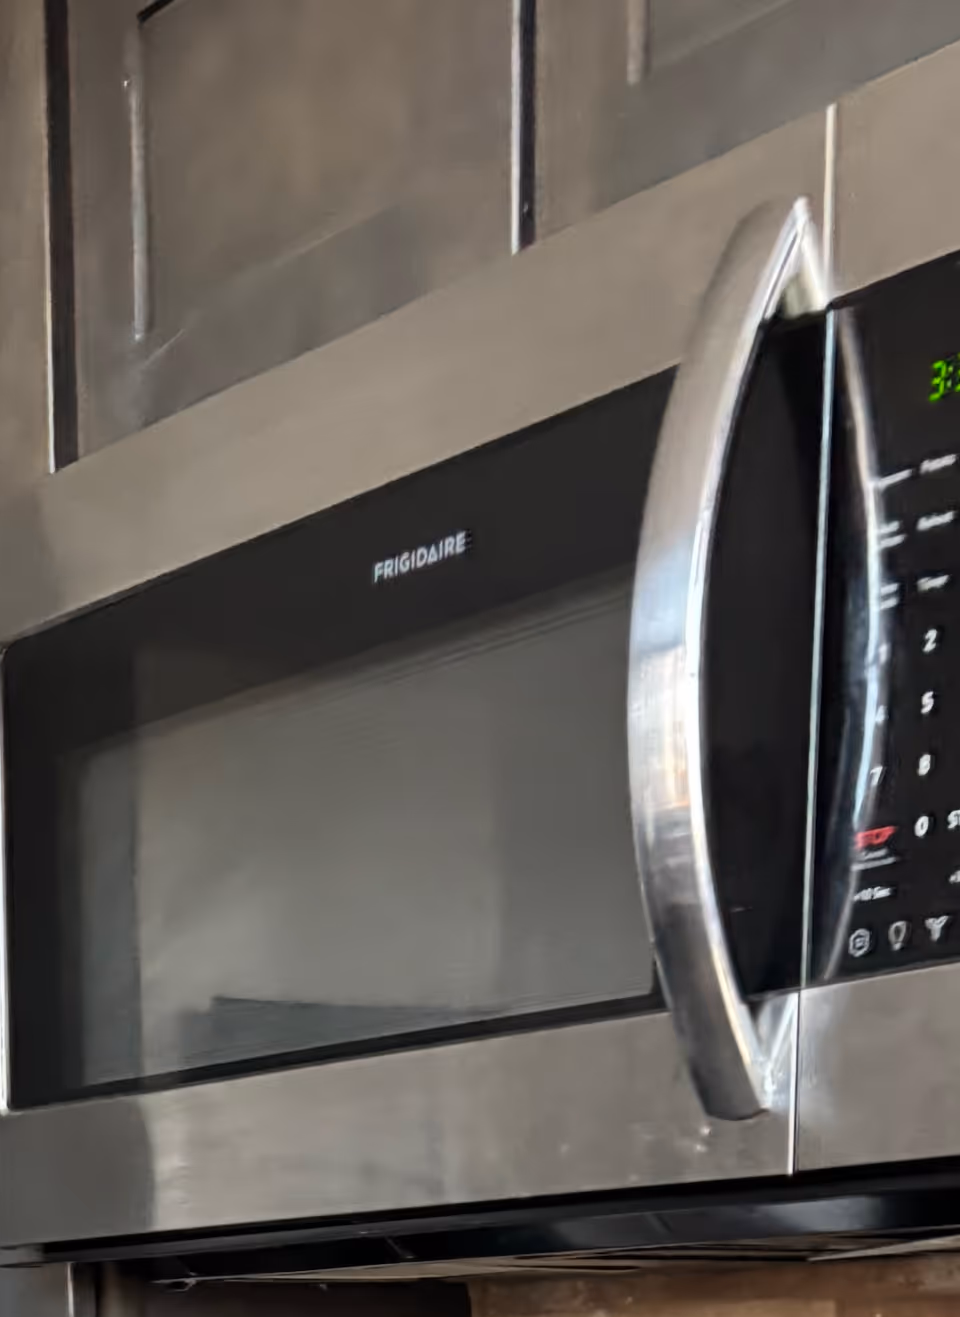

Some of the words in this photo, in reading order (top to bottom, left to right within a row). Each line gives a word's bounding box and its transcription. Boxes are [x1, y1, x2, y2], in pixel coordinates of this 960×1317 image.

[374, 530, 467, 583] FRIGIDAIRE
[922, 628, 939, 653] 2
[920, 690, 935, 715] 5
[869, 765, 884, 788] 7
[916, 754, 931, 777] 8
[914, 815, 930, 838] 0
